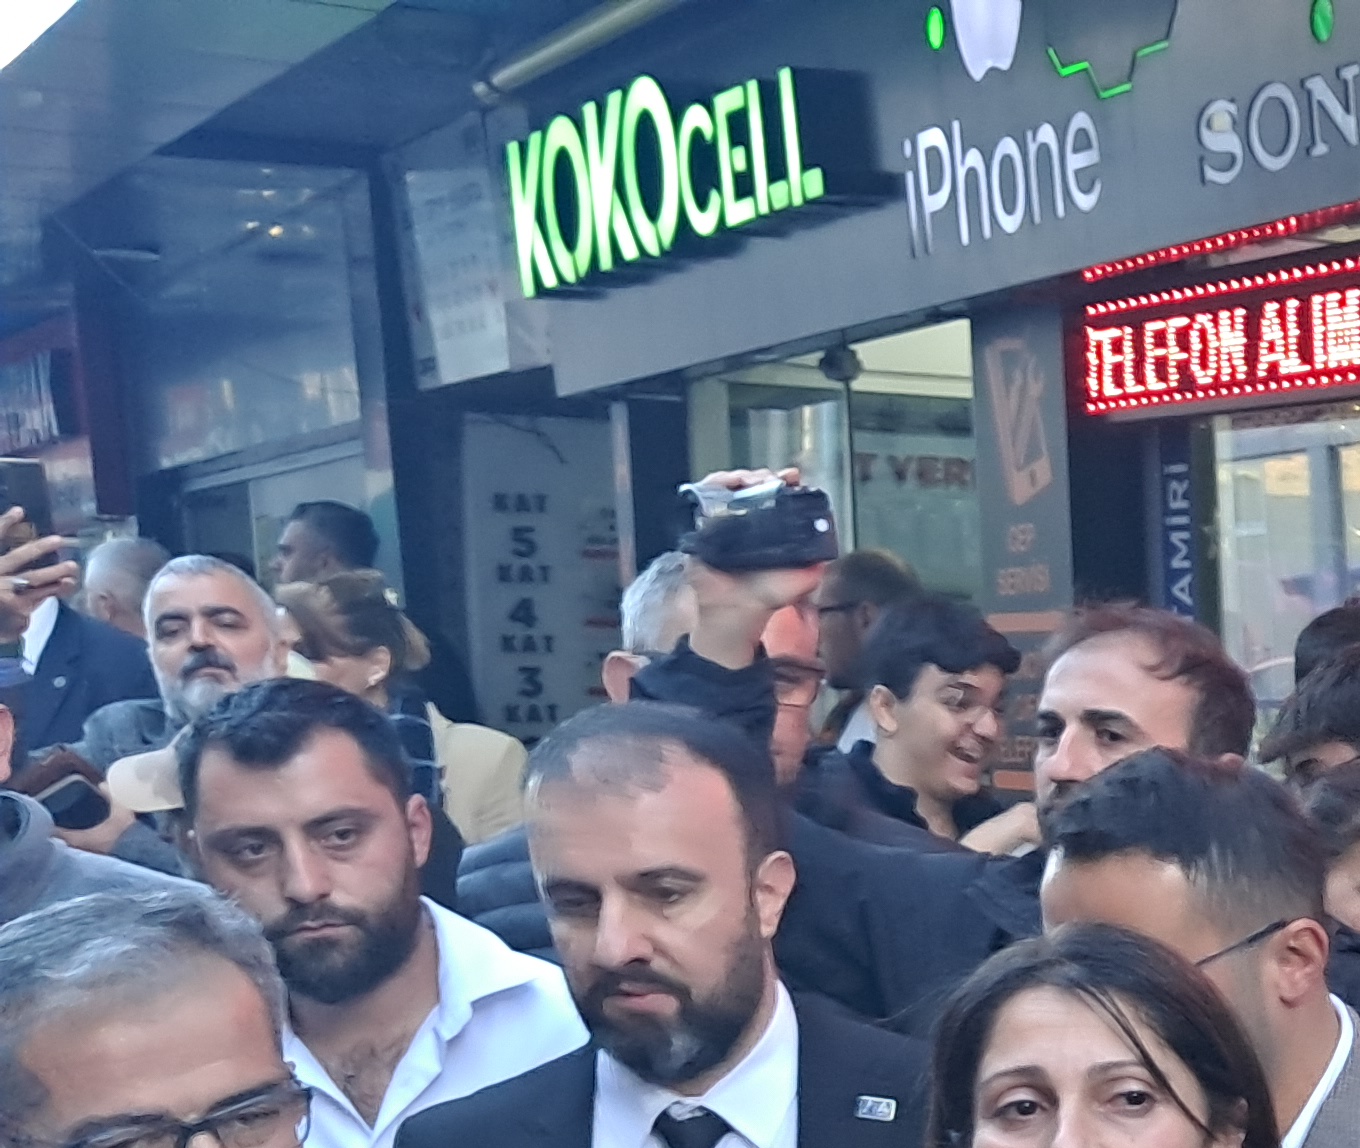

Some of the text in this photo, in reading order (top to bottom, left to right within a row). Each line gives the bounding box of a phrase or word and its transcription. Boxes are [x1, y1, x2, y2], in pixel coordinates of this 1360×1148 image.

[903, 110, 1101, 259] iPhone
[1085, 306, 1248, 398] TELEFON
[493, 492, 547, 513] KAT
[511, 525, 539, 559] 5
[496, 563, 551, 584] KAT
[507, 596, 539, 629] 4
[500, 633, 553, 653] KAT
[517, 666, 545, 698] 3
[504, 703, 558, 724] KAT
